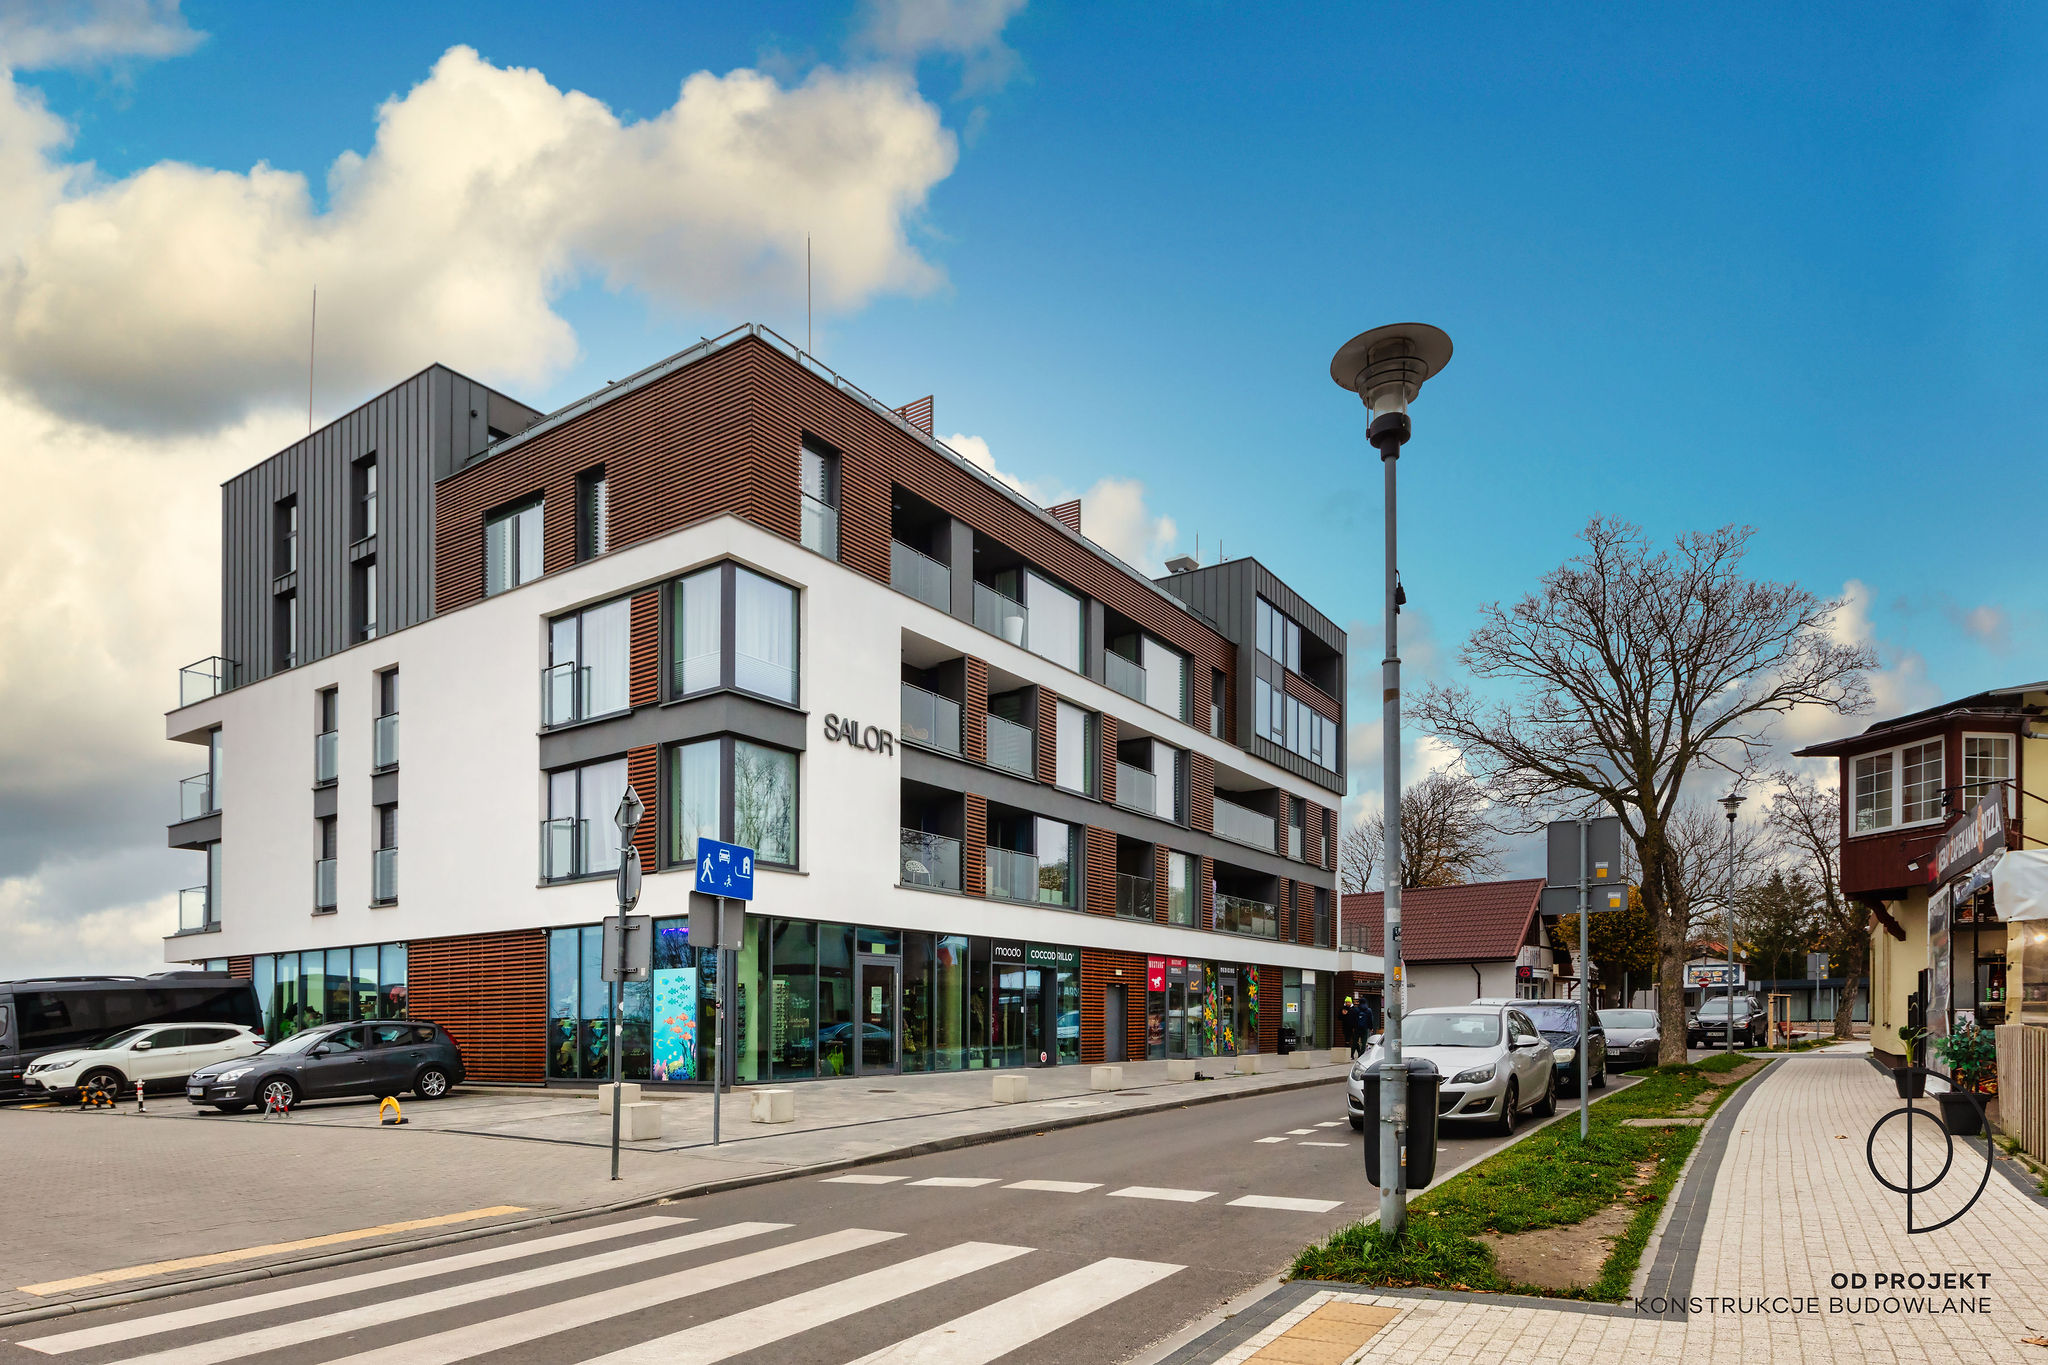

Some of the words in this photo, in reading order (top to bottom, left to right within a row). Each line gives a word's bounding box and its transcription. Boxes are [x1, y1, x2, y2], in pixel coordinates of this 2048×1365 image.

[823, 713, 893, 756] SAILOR
[1981, 802, 2001, 840] PIZZA
[995, 946, 1022, 957] moodo
